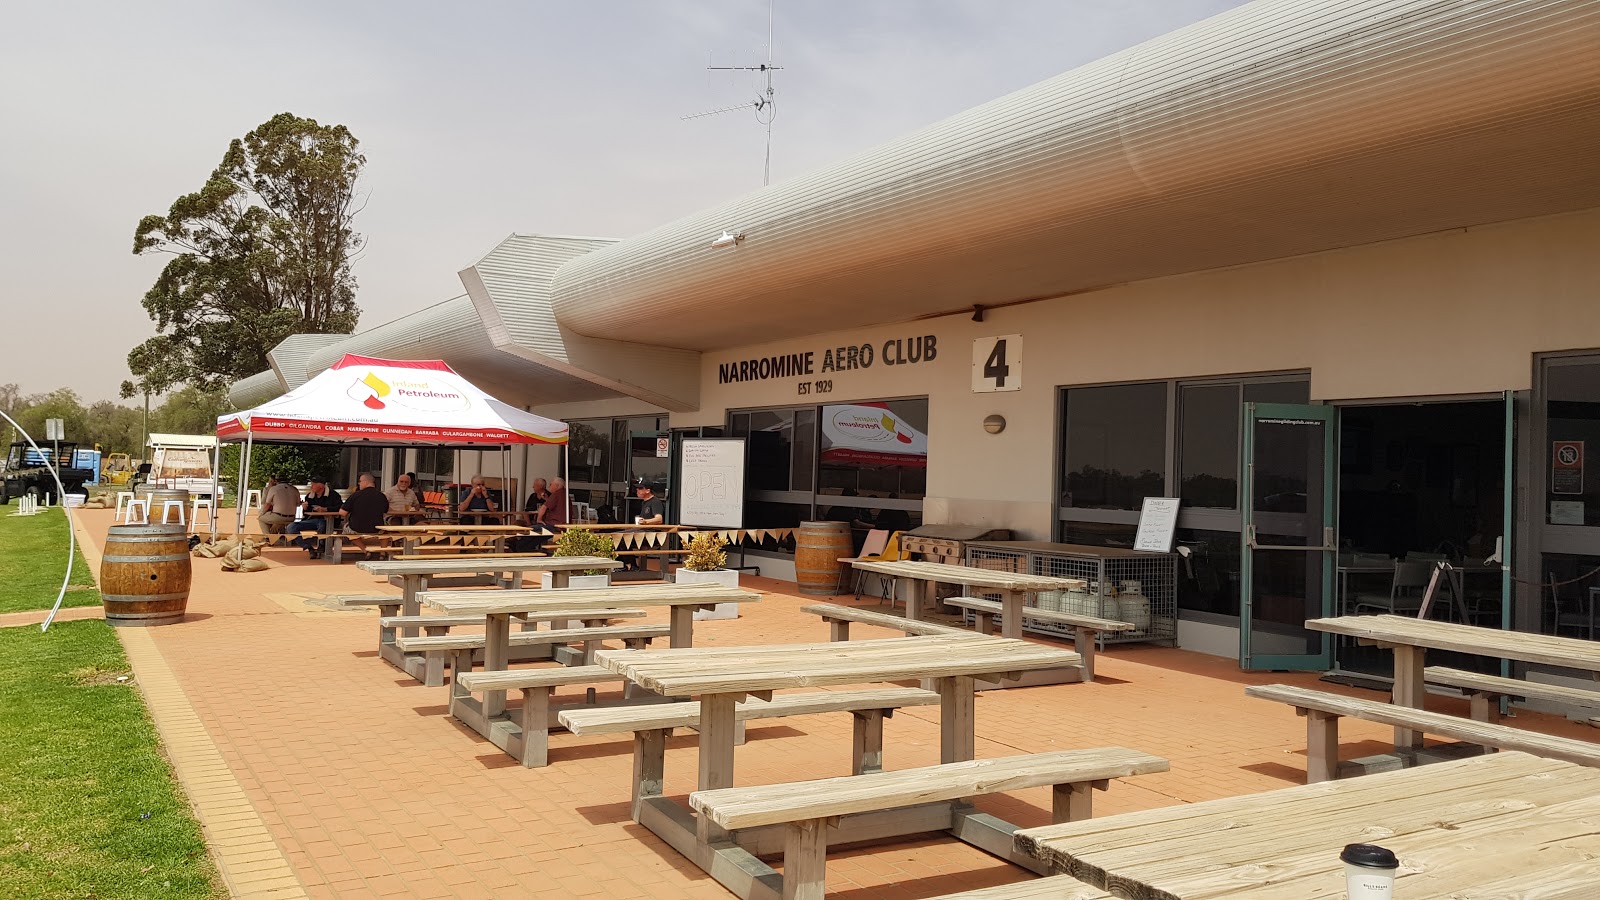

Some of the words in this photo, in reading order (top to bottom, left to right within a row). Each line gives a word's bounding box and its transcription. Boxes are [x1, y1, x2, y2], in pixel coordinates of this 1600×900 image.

[719, 351, 814, 384] NARROMINE
[821, 343, 874, 373] AERO
[882, 335, 937, 365] CLUB
[983, 339, 1009, 387] 4
[392, 380, 429, 389] Inland
[398, 388, 460, 399] Petroleum
[798, 382, 812, 395] EST
[815, 380, 833, 393] 1929
[684, 470, 739, 504] OPEN
